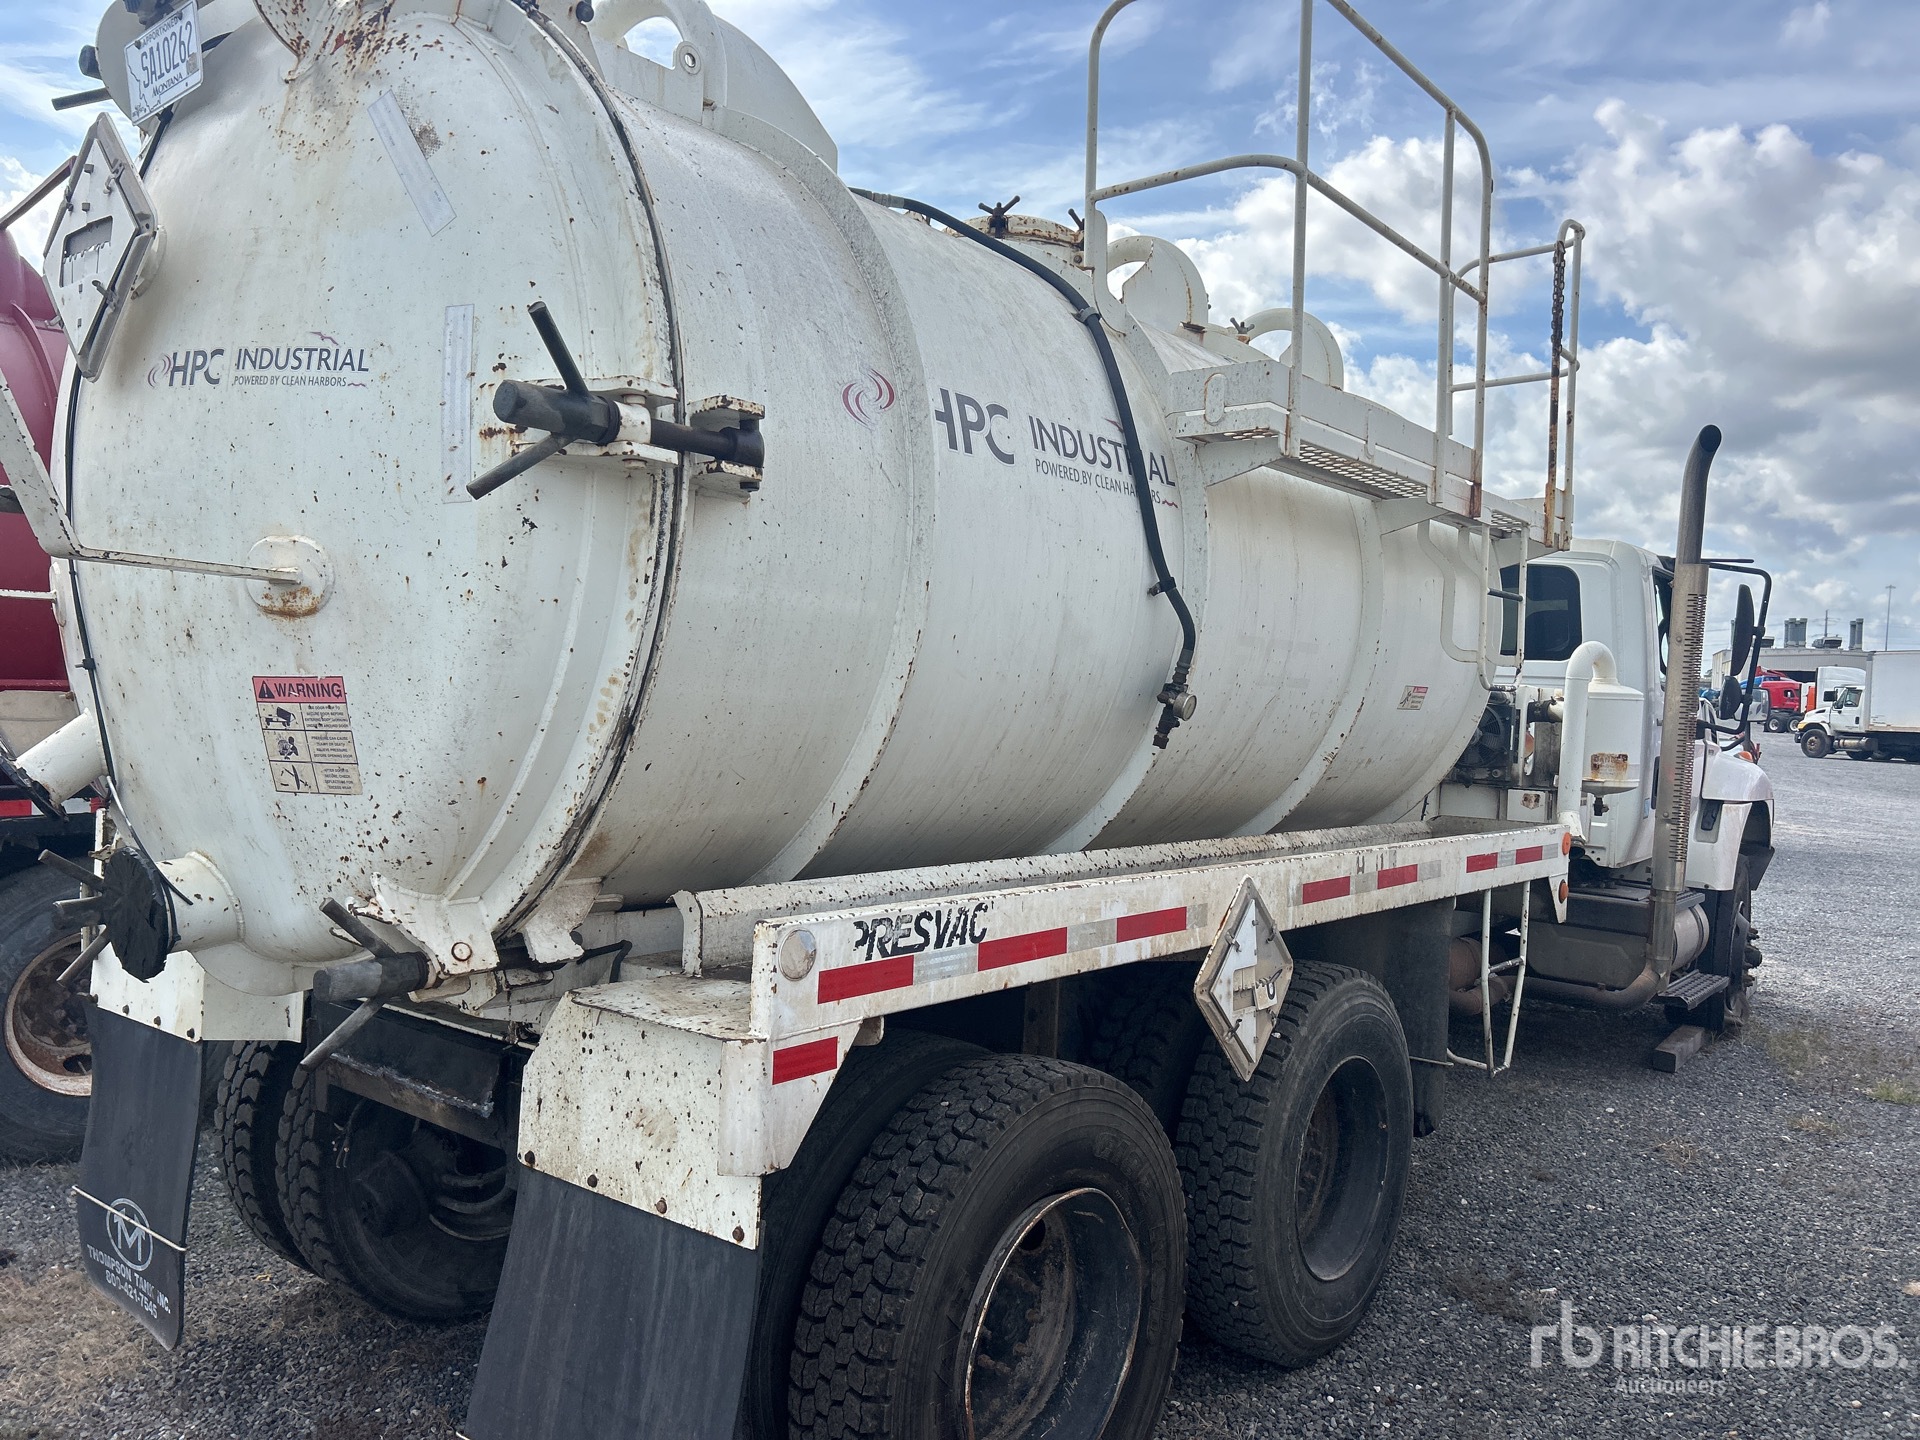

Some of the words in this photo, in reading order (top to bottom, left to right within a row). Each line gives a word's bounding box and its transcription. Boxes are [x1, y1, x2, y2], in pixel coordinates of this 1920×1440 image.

[140, 21, 193, 88] SA10262
[152, 72, 183, 98] MONTANA
[168, 348, 225, 387] HPC
[235, 347, 369, 373] INDUSTRIAL
[234, 375, 268, 386] POWERED
[270, 375, 279, 386] BY
[281, 376, 307, 387] CLEAN
[308, 376, 347, 387] HARBORS
[1028, 414, 1176, 487] INDUSTAL
[1035, 458, 1080, 483] POWERED
[1081, 473, 1092, 486] BY
[1094, 473, 1122, 494] CLEAN
[1123, 481, 1160, 504] HARS
[274, 682, 343, 699] WARNING
[86, 1243, 132, 1282] THOMPSON
